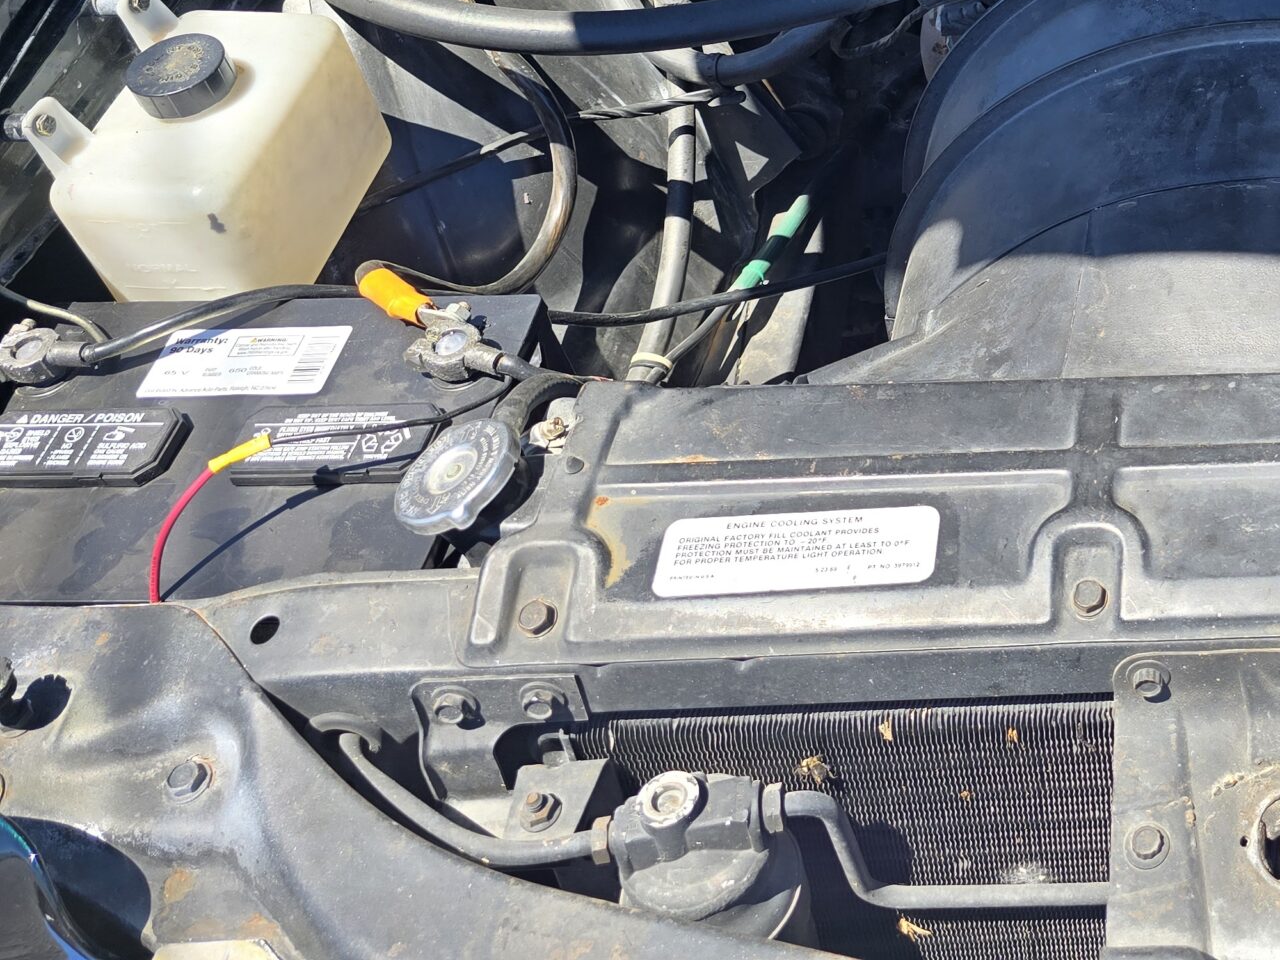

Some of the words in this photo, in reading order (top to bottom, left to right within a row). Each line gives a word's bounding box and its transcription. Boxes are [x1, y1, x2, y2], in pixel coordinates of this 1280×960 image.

[176, 336, 229, 346] Warranty:
[168, 346, 184, 354] 90
[186, 346, 214, 354] Days
[29, 414, 84, 424] DANGER
[94, 412, 146, 423] POISON
[727, 522, 767, 530] ENGINE
[770, 519, 819, 528] COOLING
[822, 516, 864, 525] SYSTEM
[724, 541, 781, 549] PROTECTION
[675, 550, 733, 559] PROTECTION
[777, 544, 833, 553] MAINTAINED
[734, 554, 800, 563] TEMPERATURE
